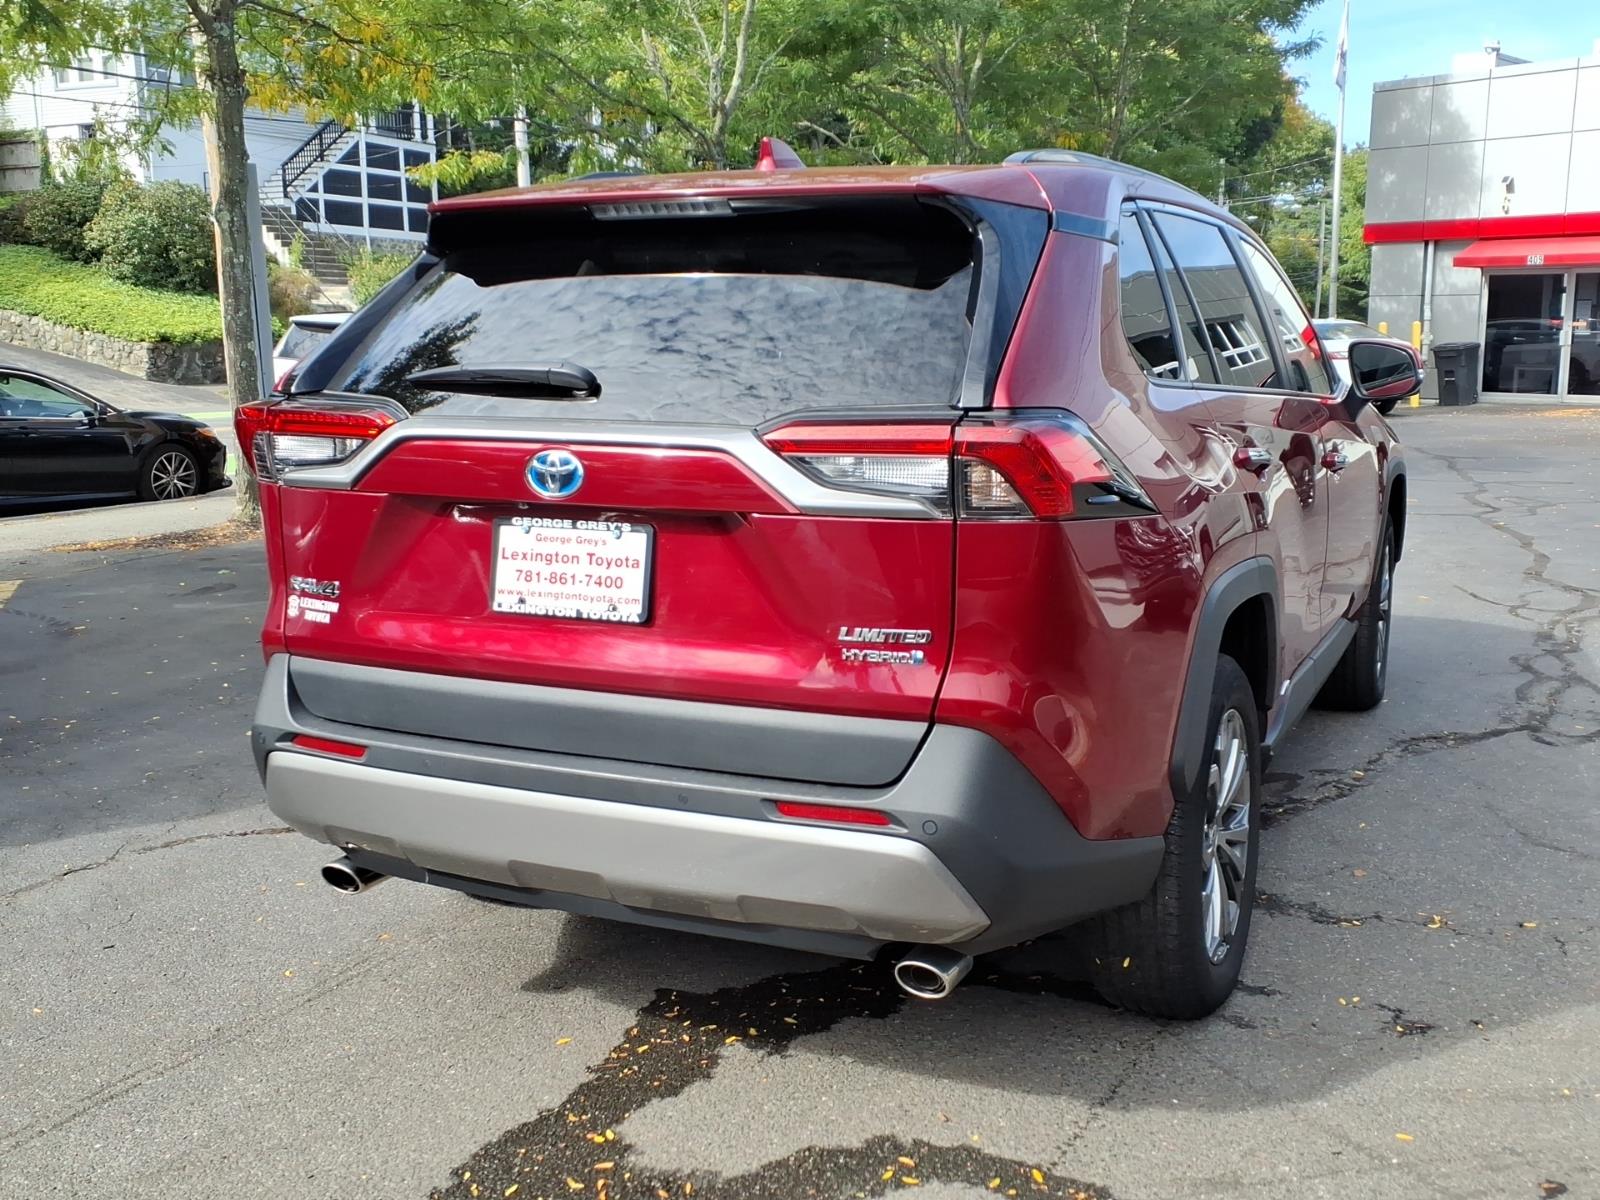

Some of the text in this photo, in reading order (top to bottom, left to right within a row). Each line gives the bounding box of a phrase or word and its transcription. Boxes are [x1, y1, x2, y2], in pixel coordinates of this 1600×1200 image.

[511, 516, 632, 532] GEORGE GREY'S
[535, 533, 607, 547] George Grey's
[501, 547, 641, 569] Lexington Toyota
[515, 569, 624, 589] 781-861-7400
[497, 588, 641, 605] www.lexingtontoyota.com
[579, 608, 641, 623] TOYOTA
[838, 626, 932, 644] LIMITED
[841, 648, 911, 664] HYBRID
